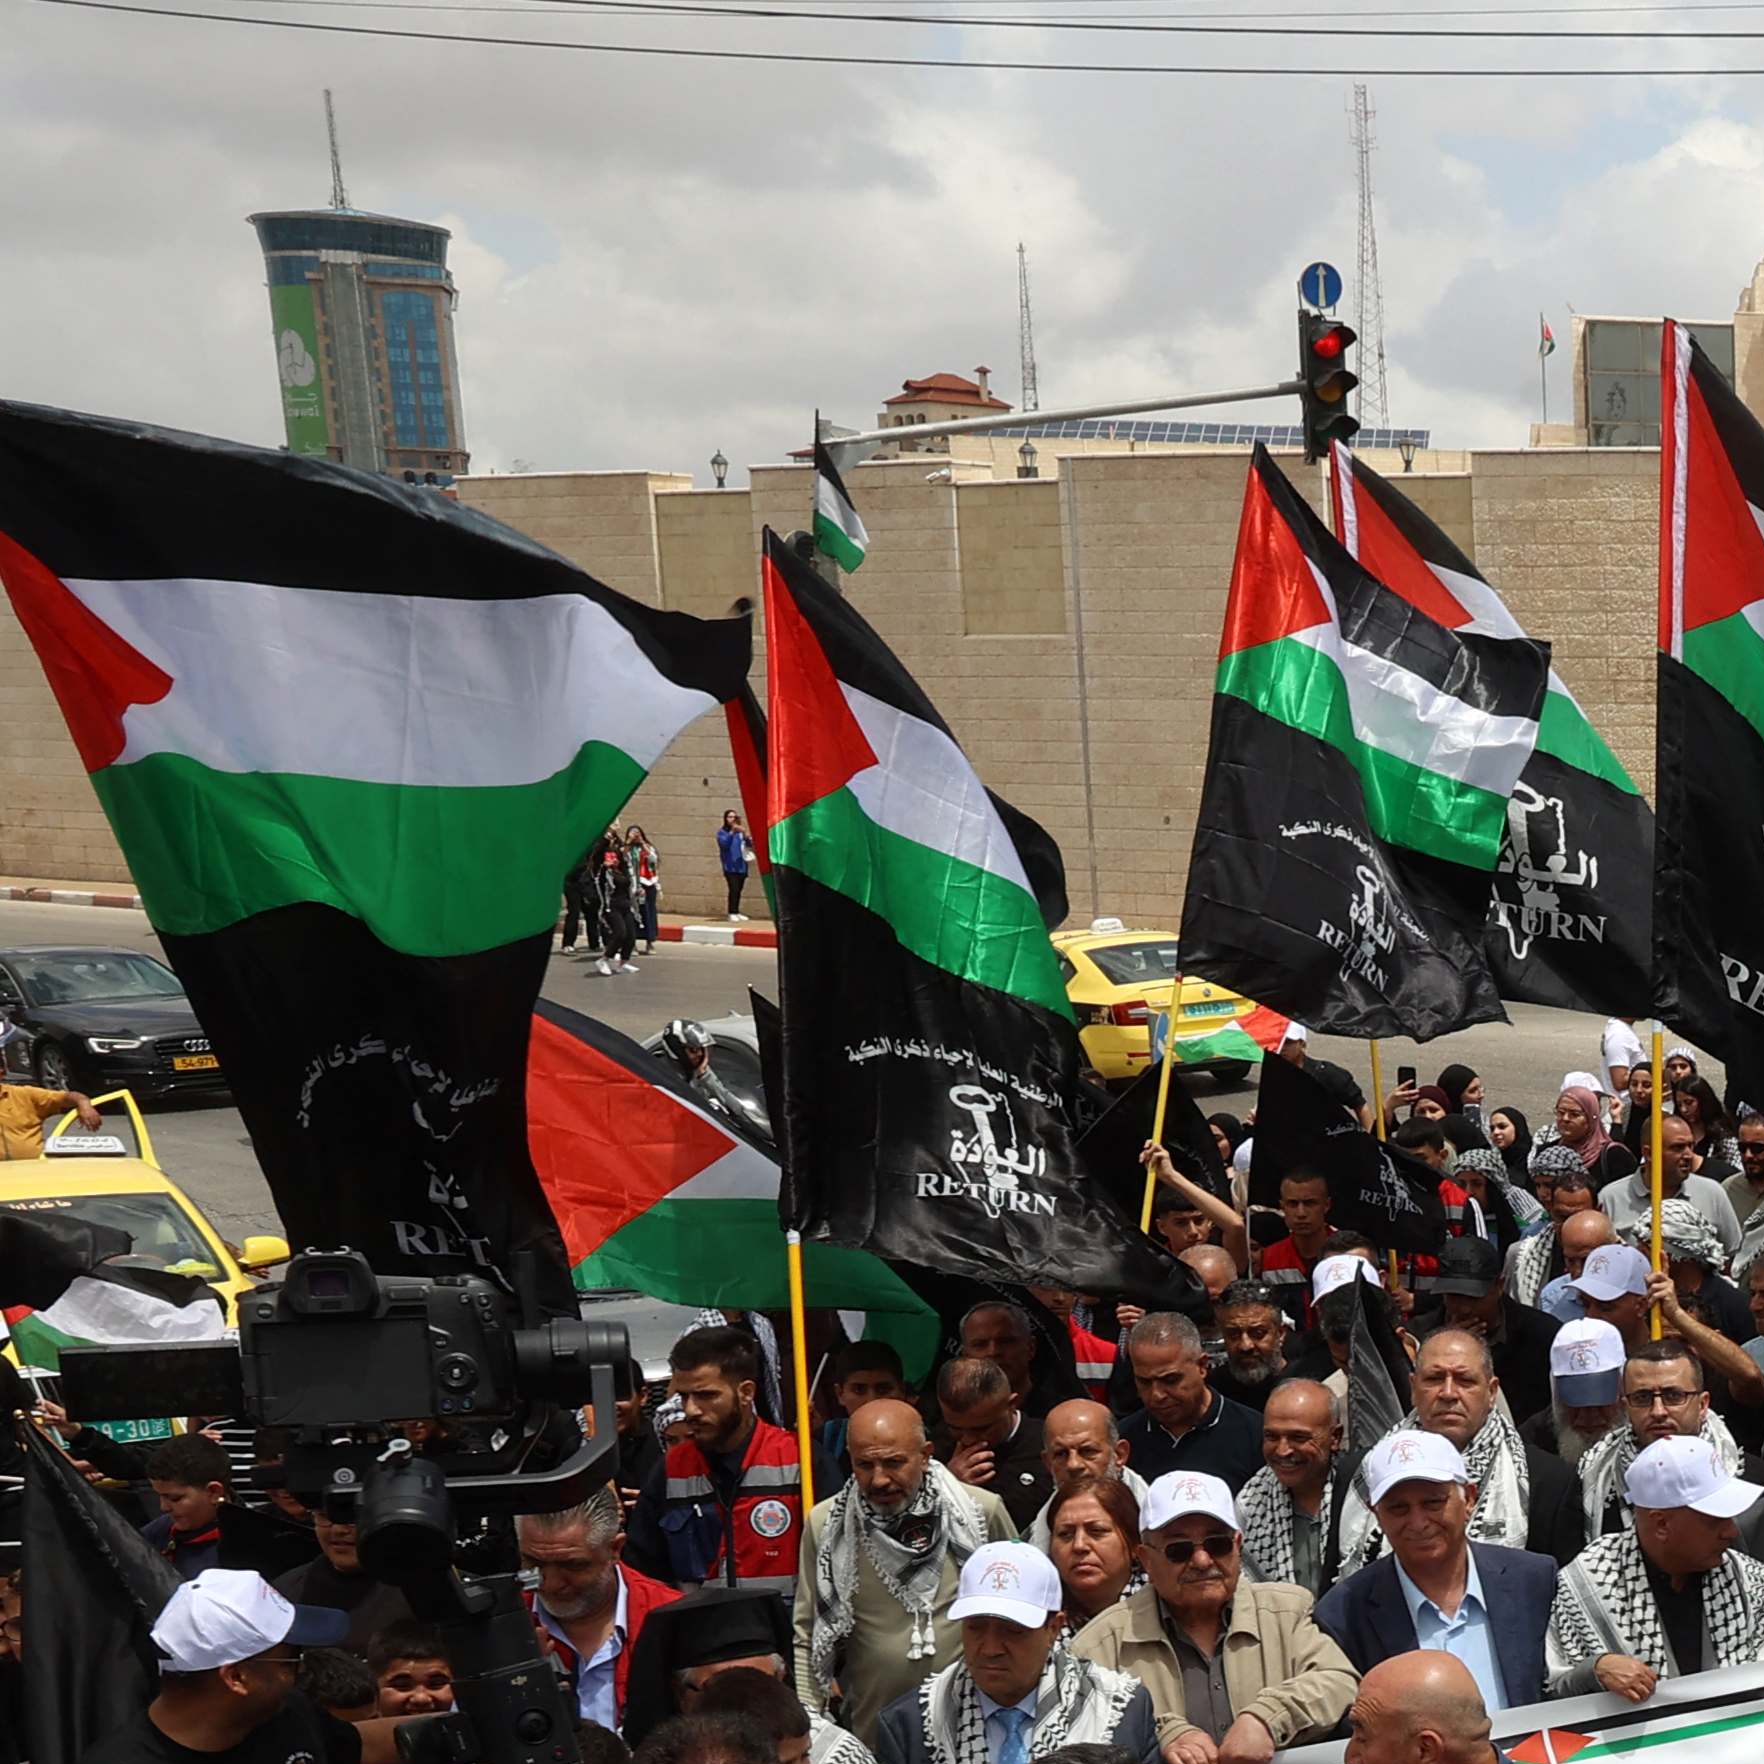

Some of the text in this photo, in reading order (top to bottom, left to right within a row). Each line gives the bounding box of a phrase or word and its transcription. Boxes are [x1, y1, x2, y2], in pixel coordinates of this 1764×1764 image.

[1316, 919, 1389, 992] RETURN
[951, 1129, 1046, 1177] العودة
[916, 1172, 1058, 1216] RETURN
